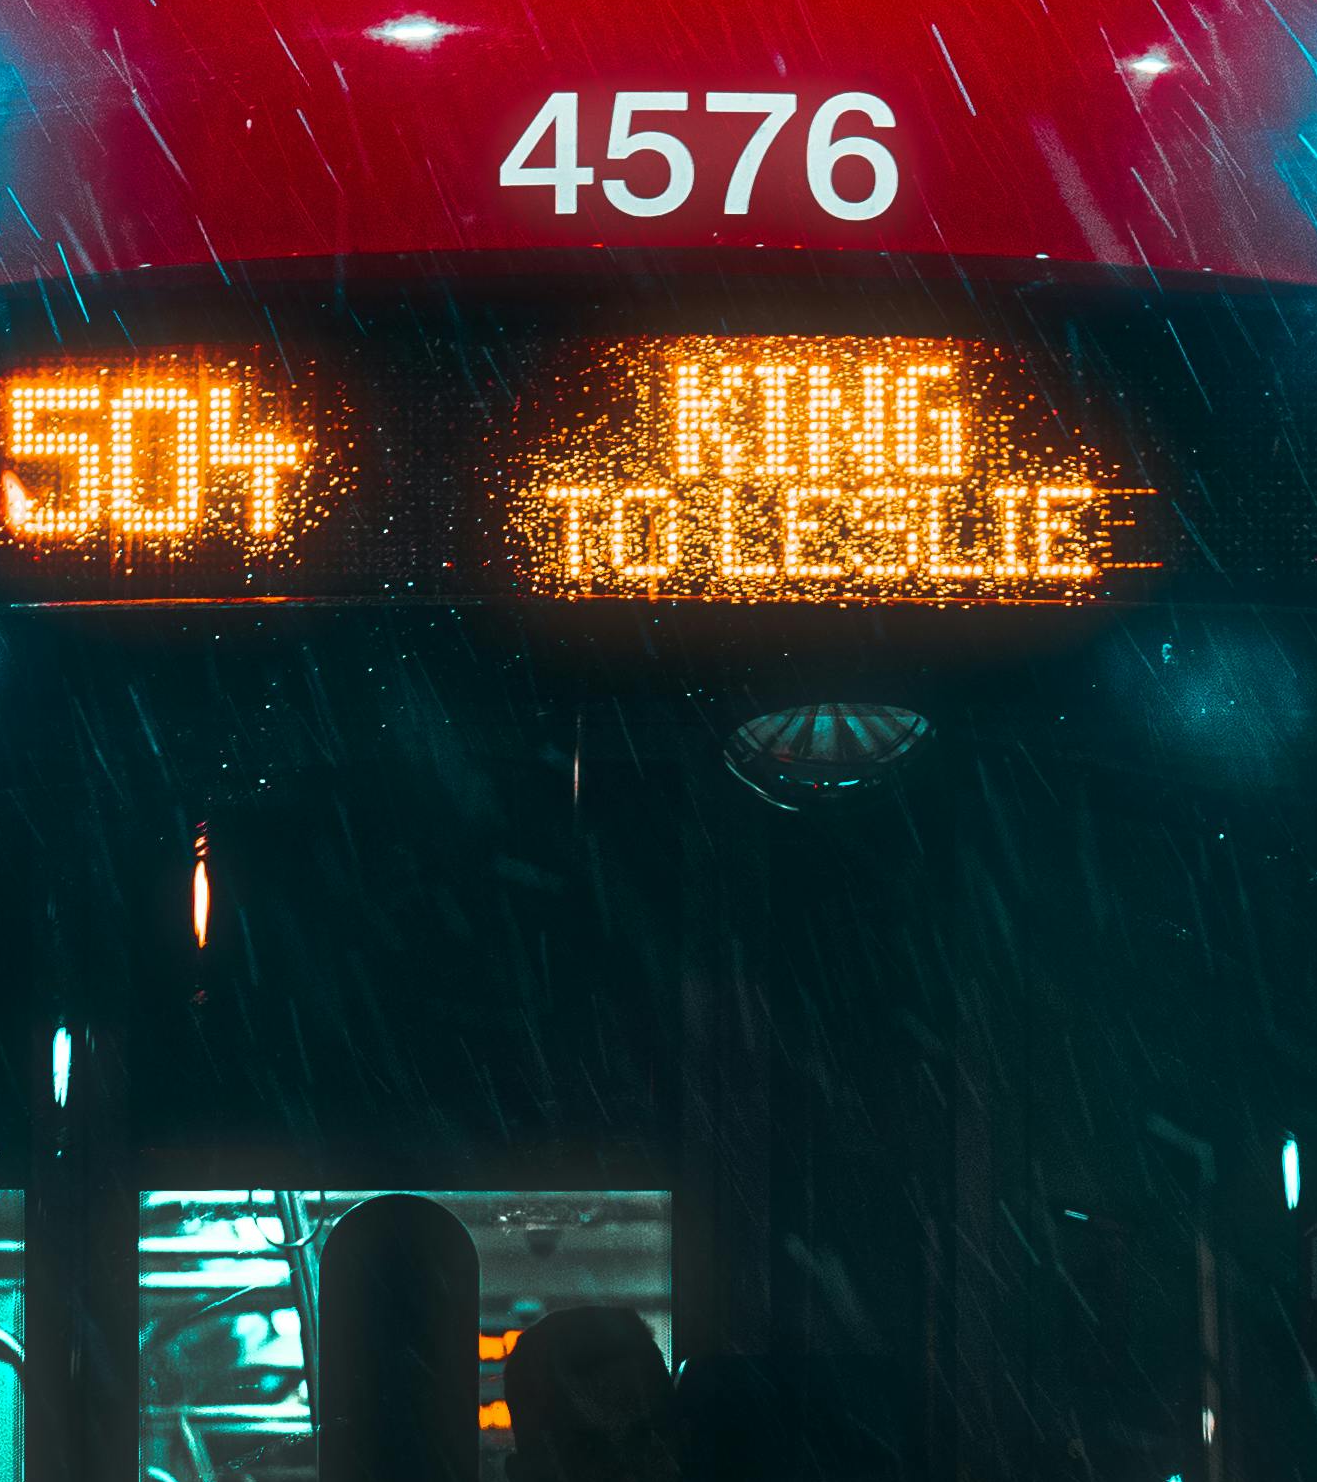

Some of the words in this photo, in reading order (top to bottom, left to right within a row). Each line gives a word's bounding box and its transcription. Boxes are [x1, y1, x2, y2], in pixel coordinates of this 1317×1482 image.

[499, 91, 899, 221] 4576
[1, 386, 297, 533] 504
[677, 365, 963, 476] KING
[546, 487, 681, 577] TO
[722, 487, 1095, 577] LESLIE
